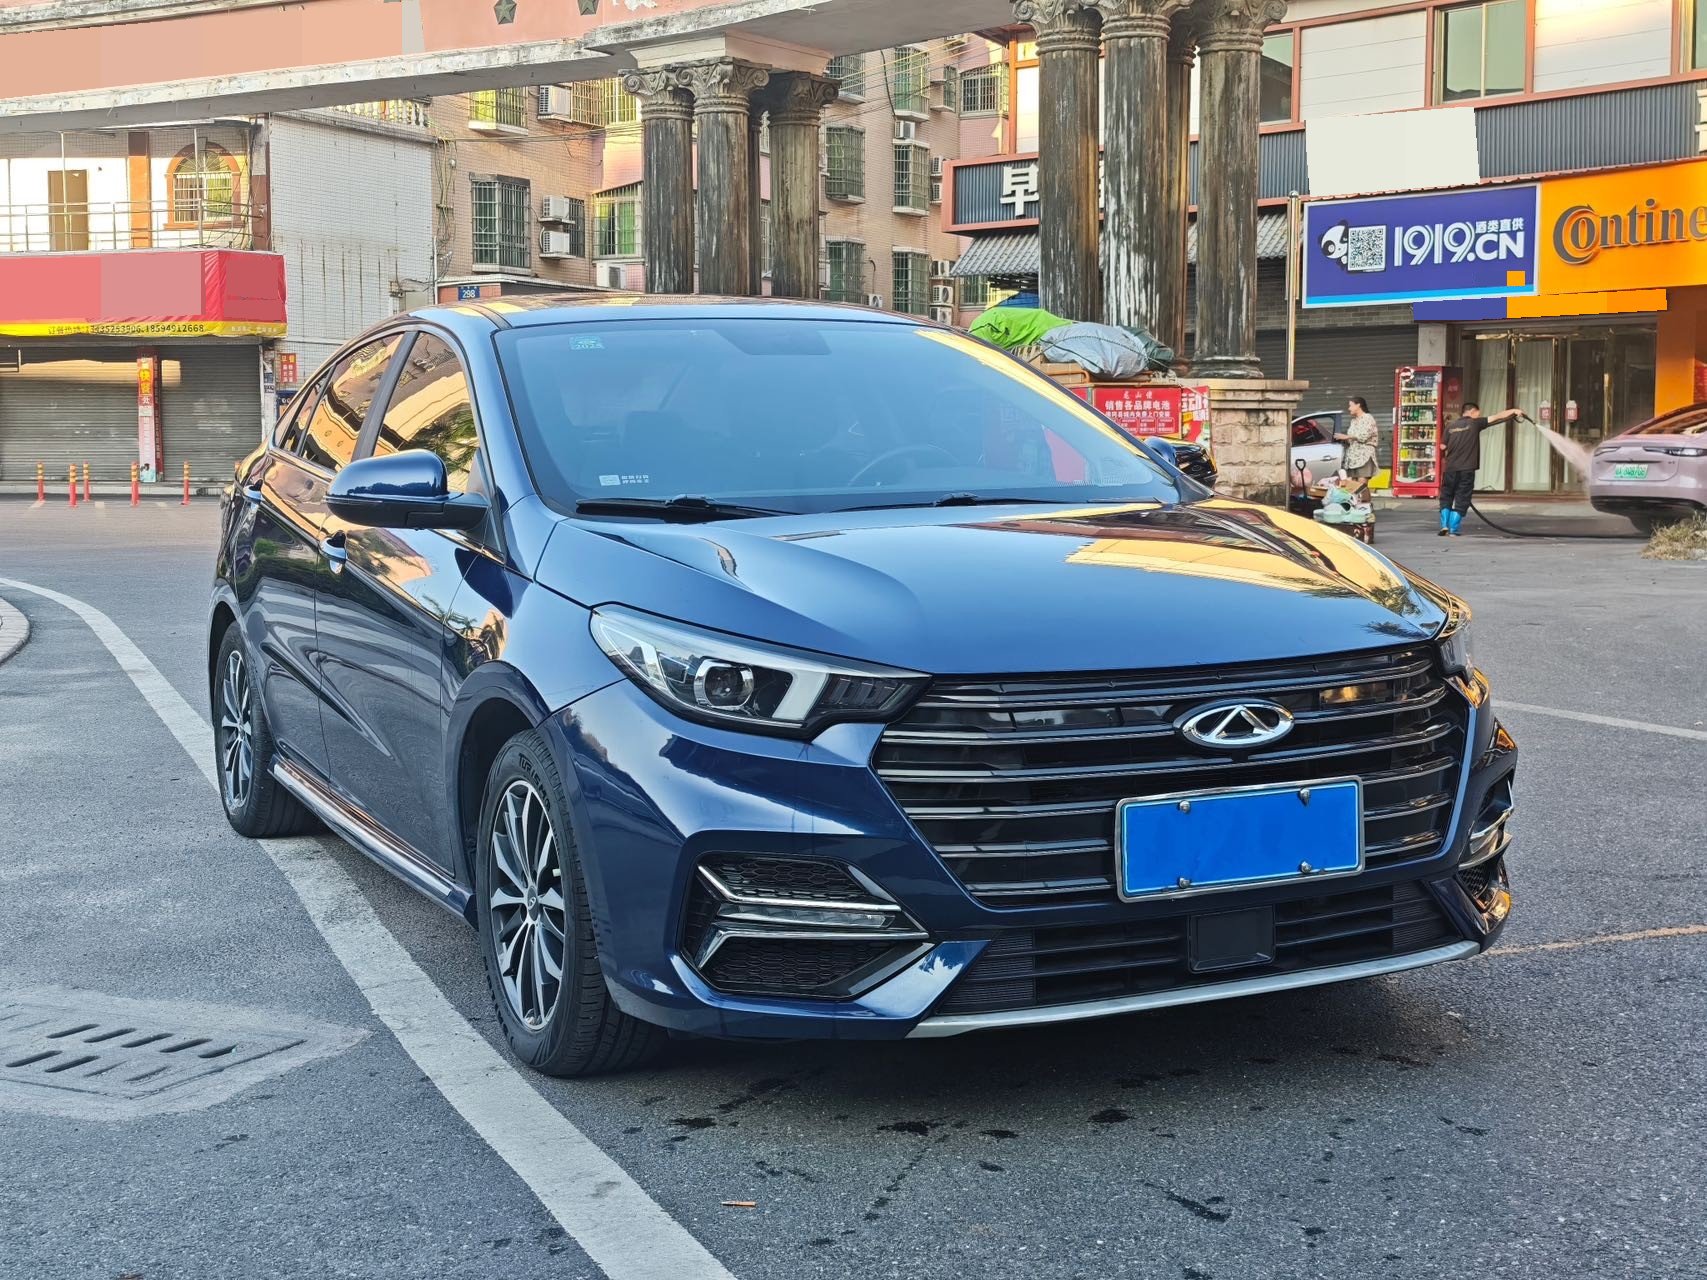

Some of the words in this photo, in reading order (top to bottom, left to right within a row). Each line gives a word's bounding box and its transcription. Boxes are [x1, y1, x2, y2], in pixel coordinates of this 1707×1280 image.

[1000, 163, 1040, 217] 早
[1475, 217, 1524, 234] 酒类直供
[1394, 221, 1525, 267] 1919.CN
[462, 289, 475, 299] 298
[1105, 400, 1171, 411] 销售各品牌电池
